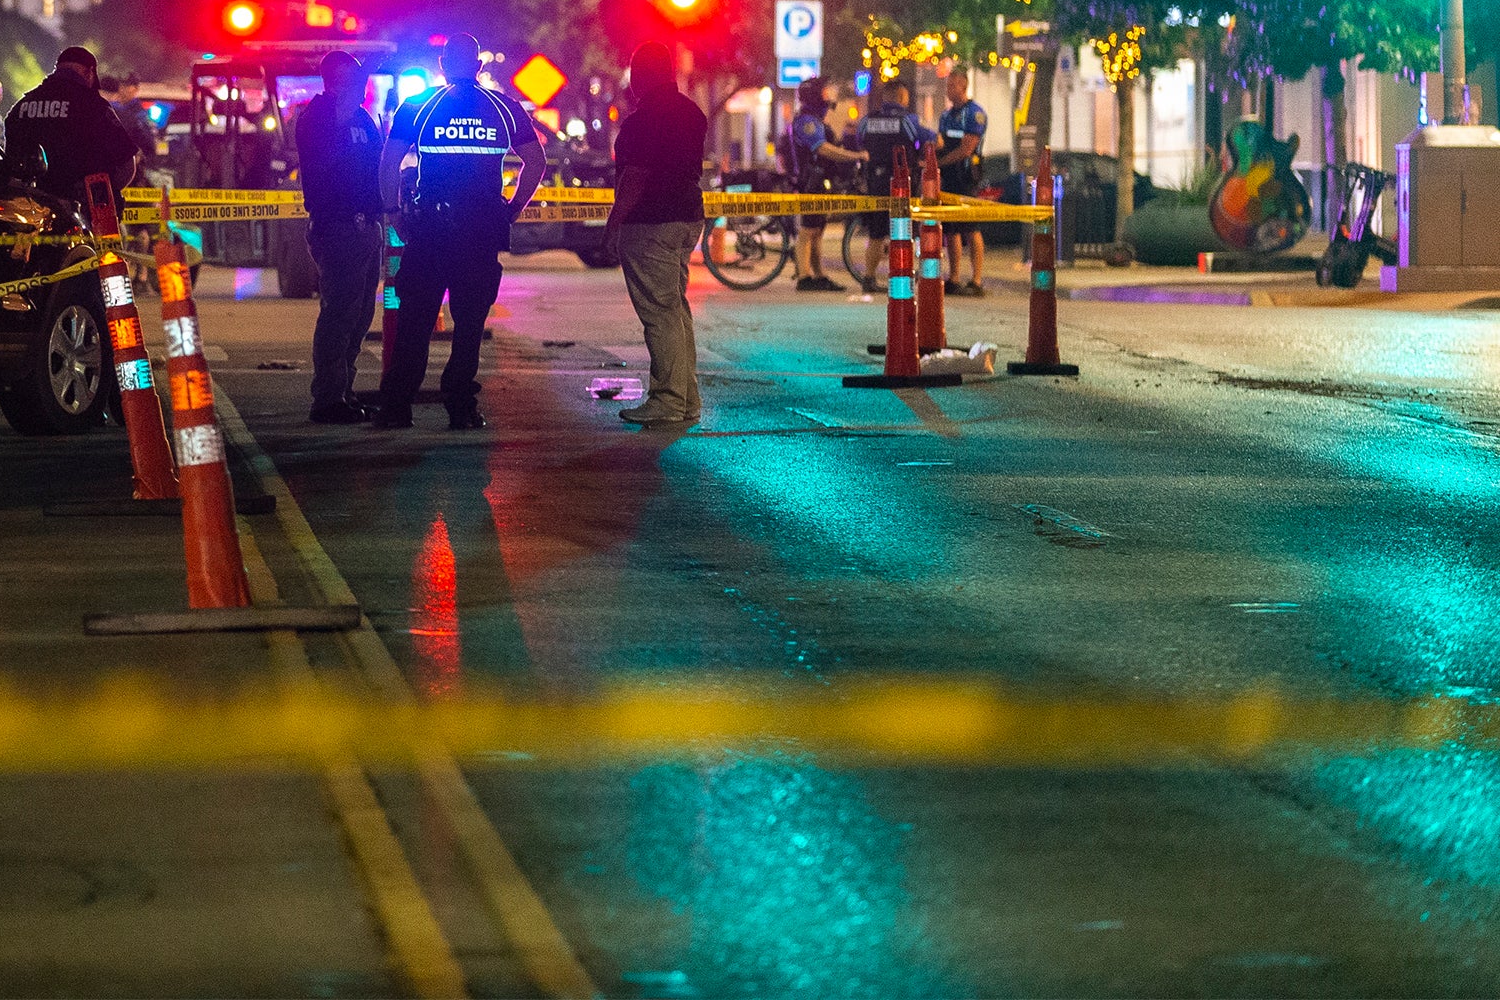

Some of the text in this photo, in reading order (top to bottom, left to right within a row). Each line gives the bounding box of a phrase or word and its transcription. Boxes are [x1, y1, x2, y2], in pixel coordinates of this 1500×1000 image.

[19, 100, 70, 118] POLICE
[449, 117, 482, 126] AUSTIN
[434, 126, 497, 141] POLICE
[175, 208, 200, 219] CROSS
[202, 208, 218, 218] NOT
[220, 207, 230, 217] DO
[233, 206, 250, 217] LINE
[252, 205, 279, 216] POLICE
